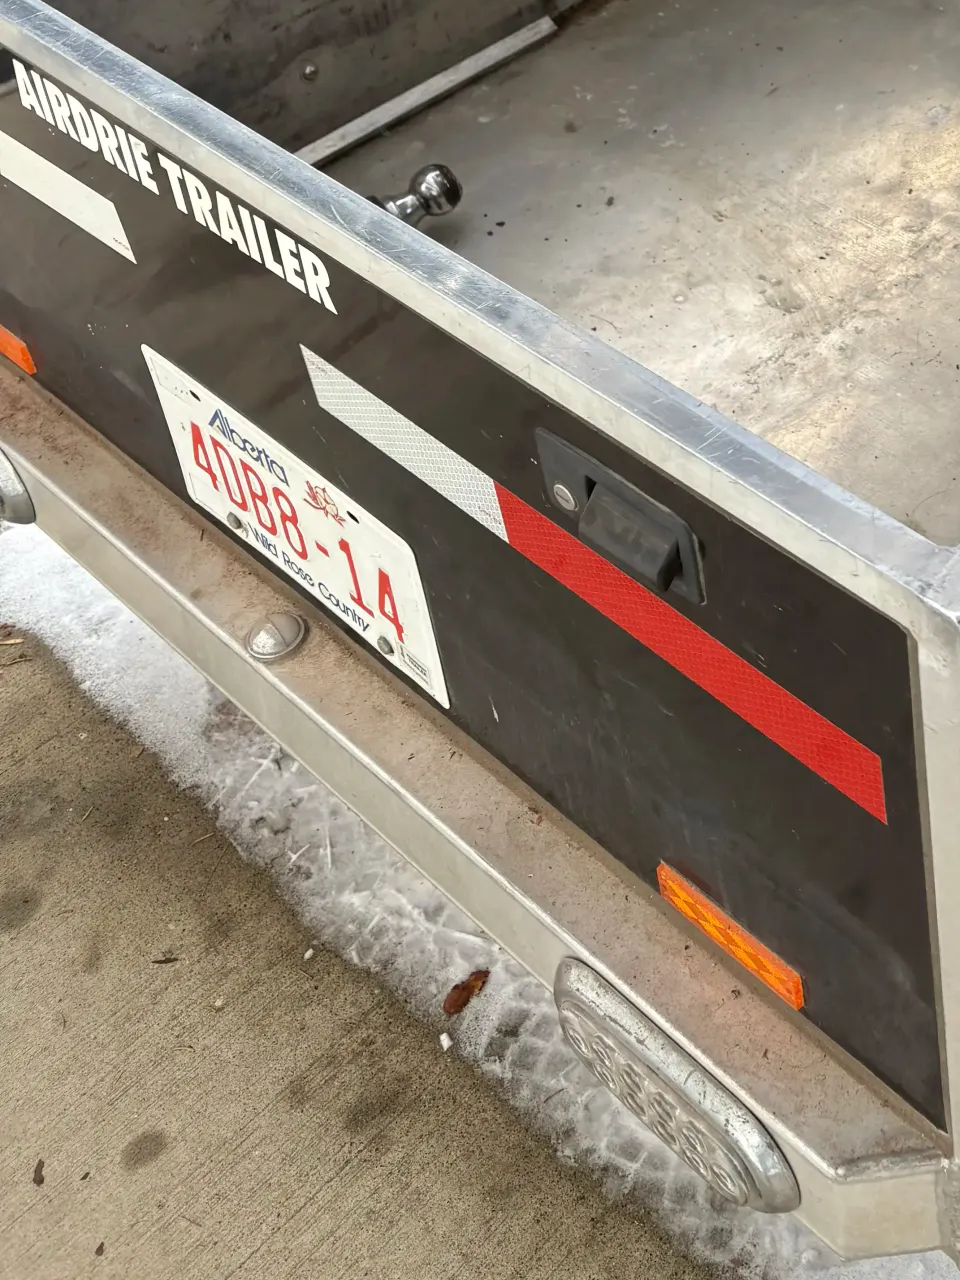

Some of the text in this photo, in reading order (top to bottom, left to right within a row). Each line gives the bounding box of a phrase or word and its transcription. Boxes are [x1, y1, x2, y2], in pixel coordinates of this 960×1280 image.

[12, 58, 338, 315] AIRDRIE TRAILER
[207, 408, 290, 487] Alberta
[190, 421, 405, 644] 4DB8-14
[247, 521, 371, 632] Wild Rose Country
